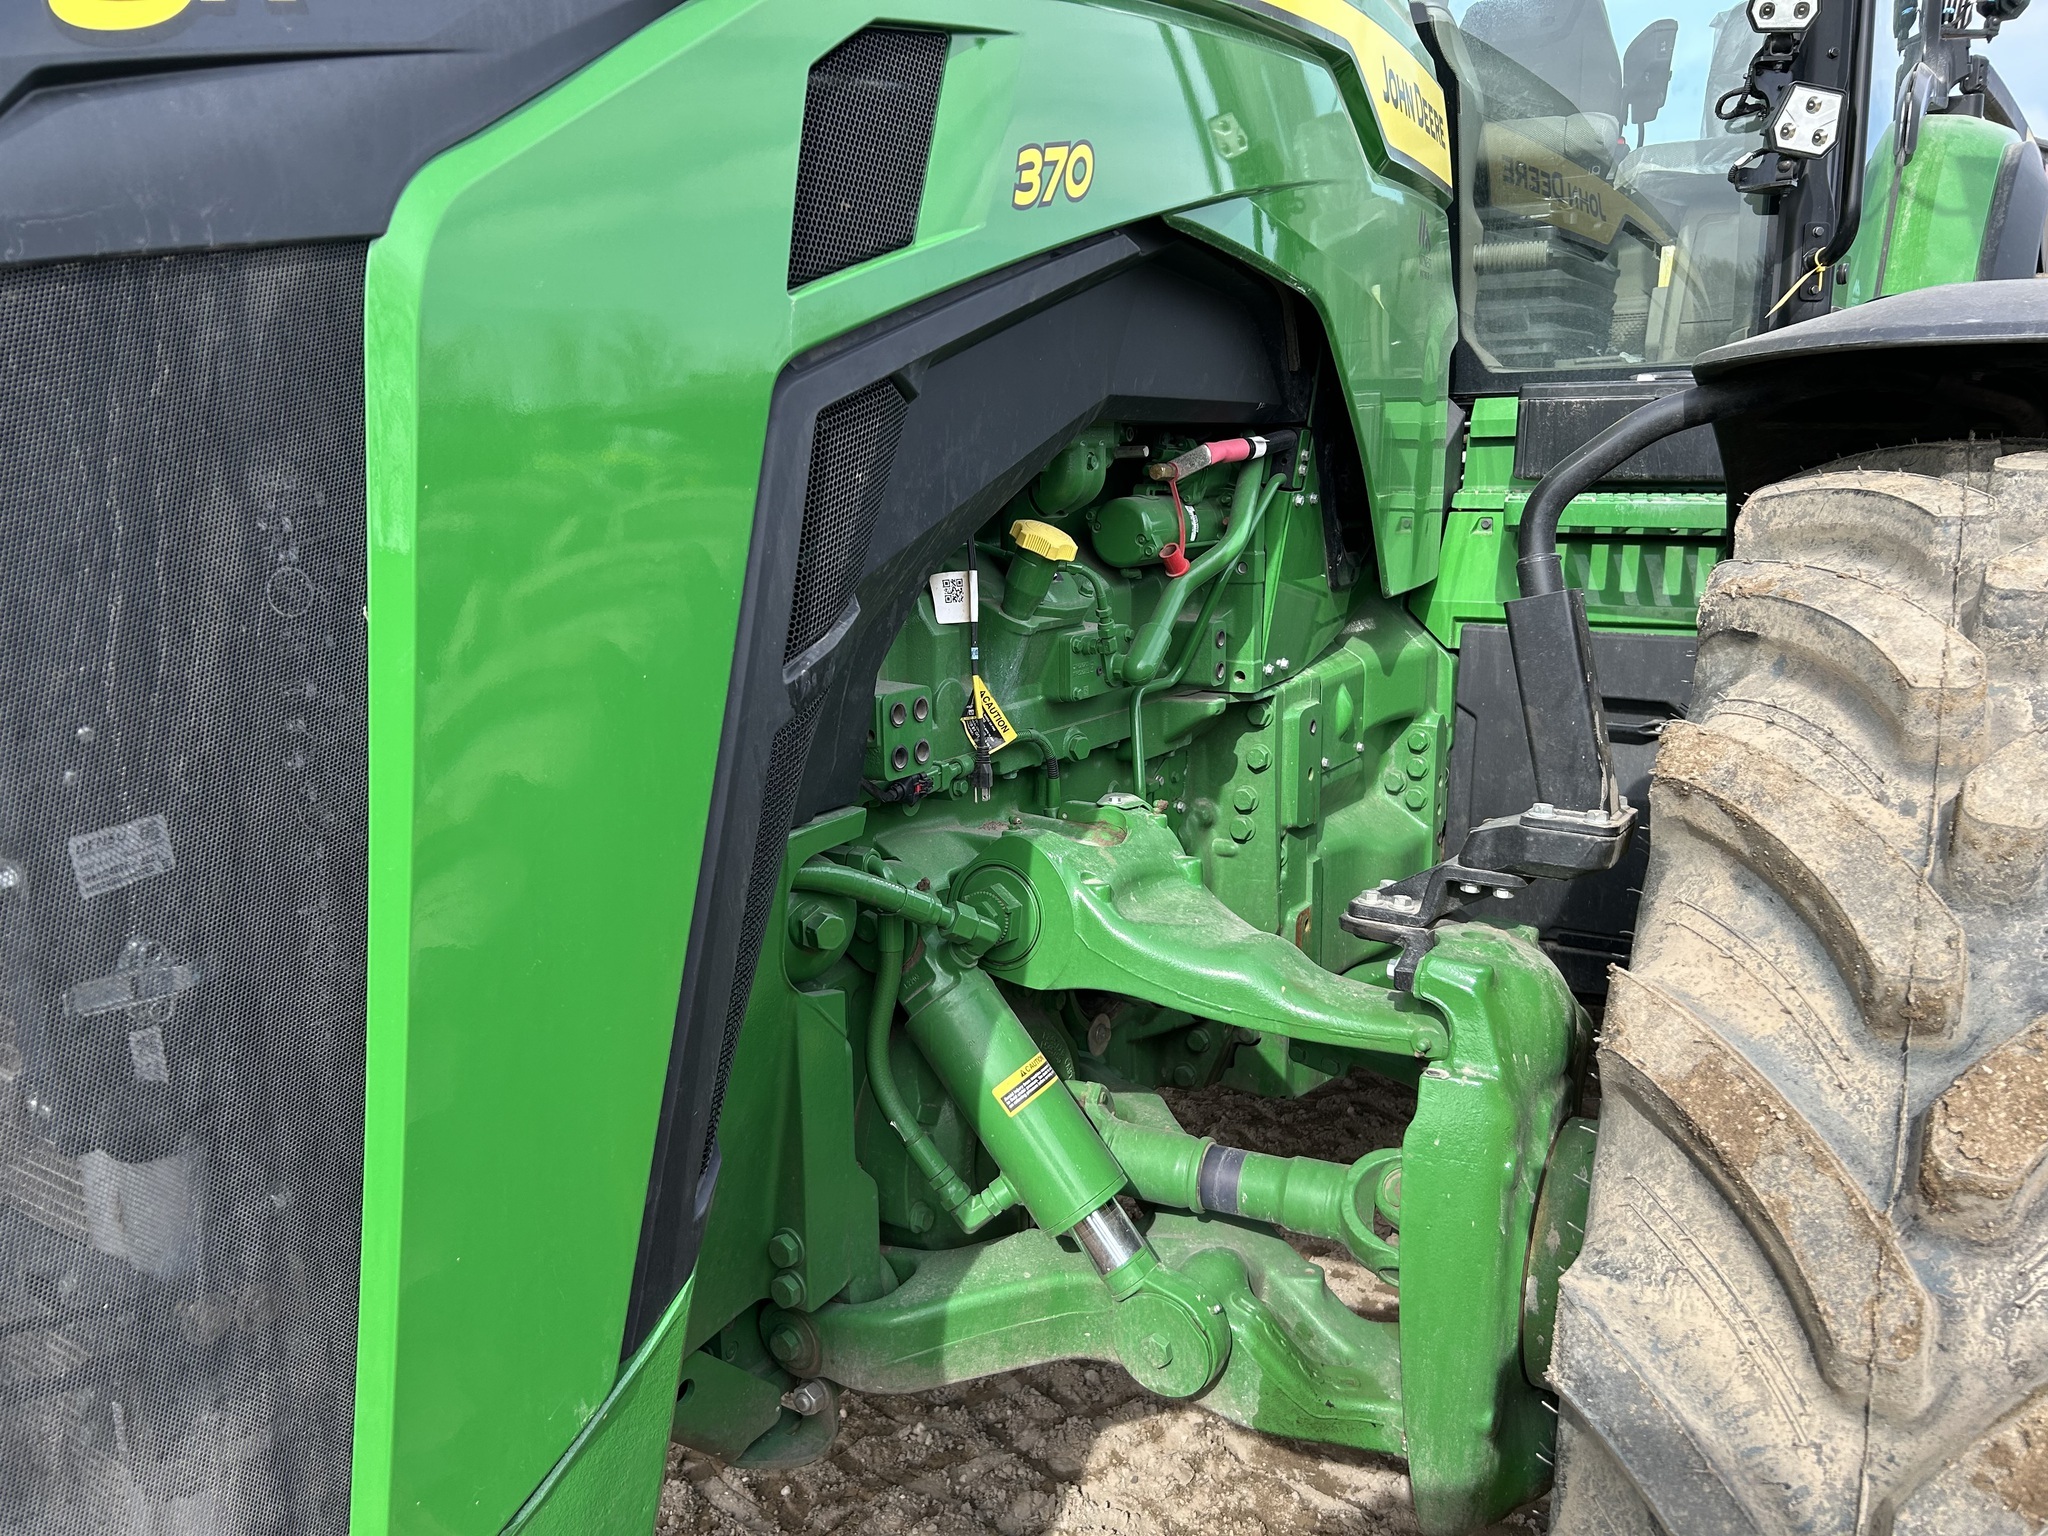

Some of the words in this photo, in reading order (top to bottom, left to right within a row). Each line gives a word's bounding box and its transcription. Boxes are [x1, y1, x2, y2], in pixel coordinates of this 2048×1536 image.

[1382, 55, 1416, 123] JOHN
[1414, 82, 1446, 150] DEERE
[1012, 139, 1095, 211] 370
[982, 696, 1010, 733] CAUTION
